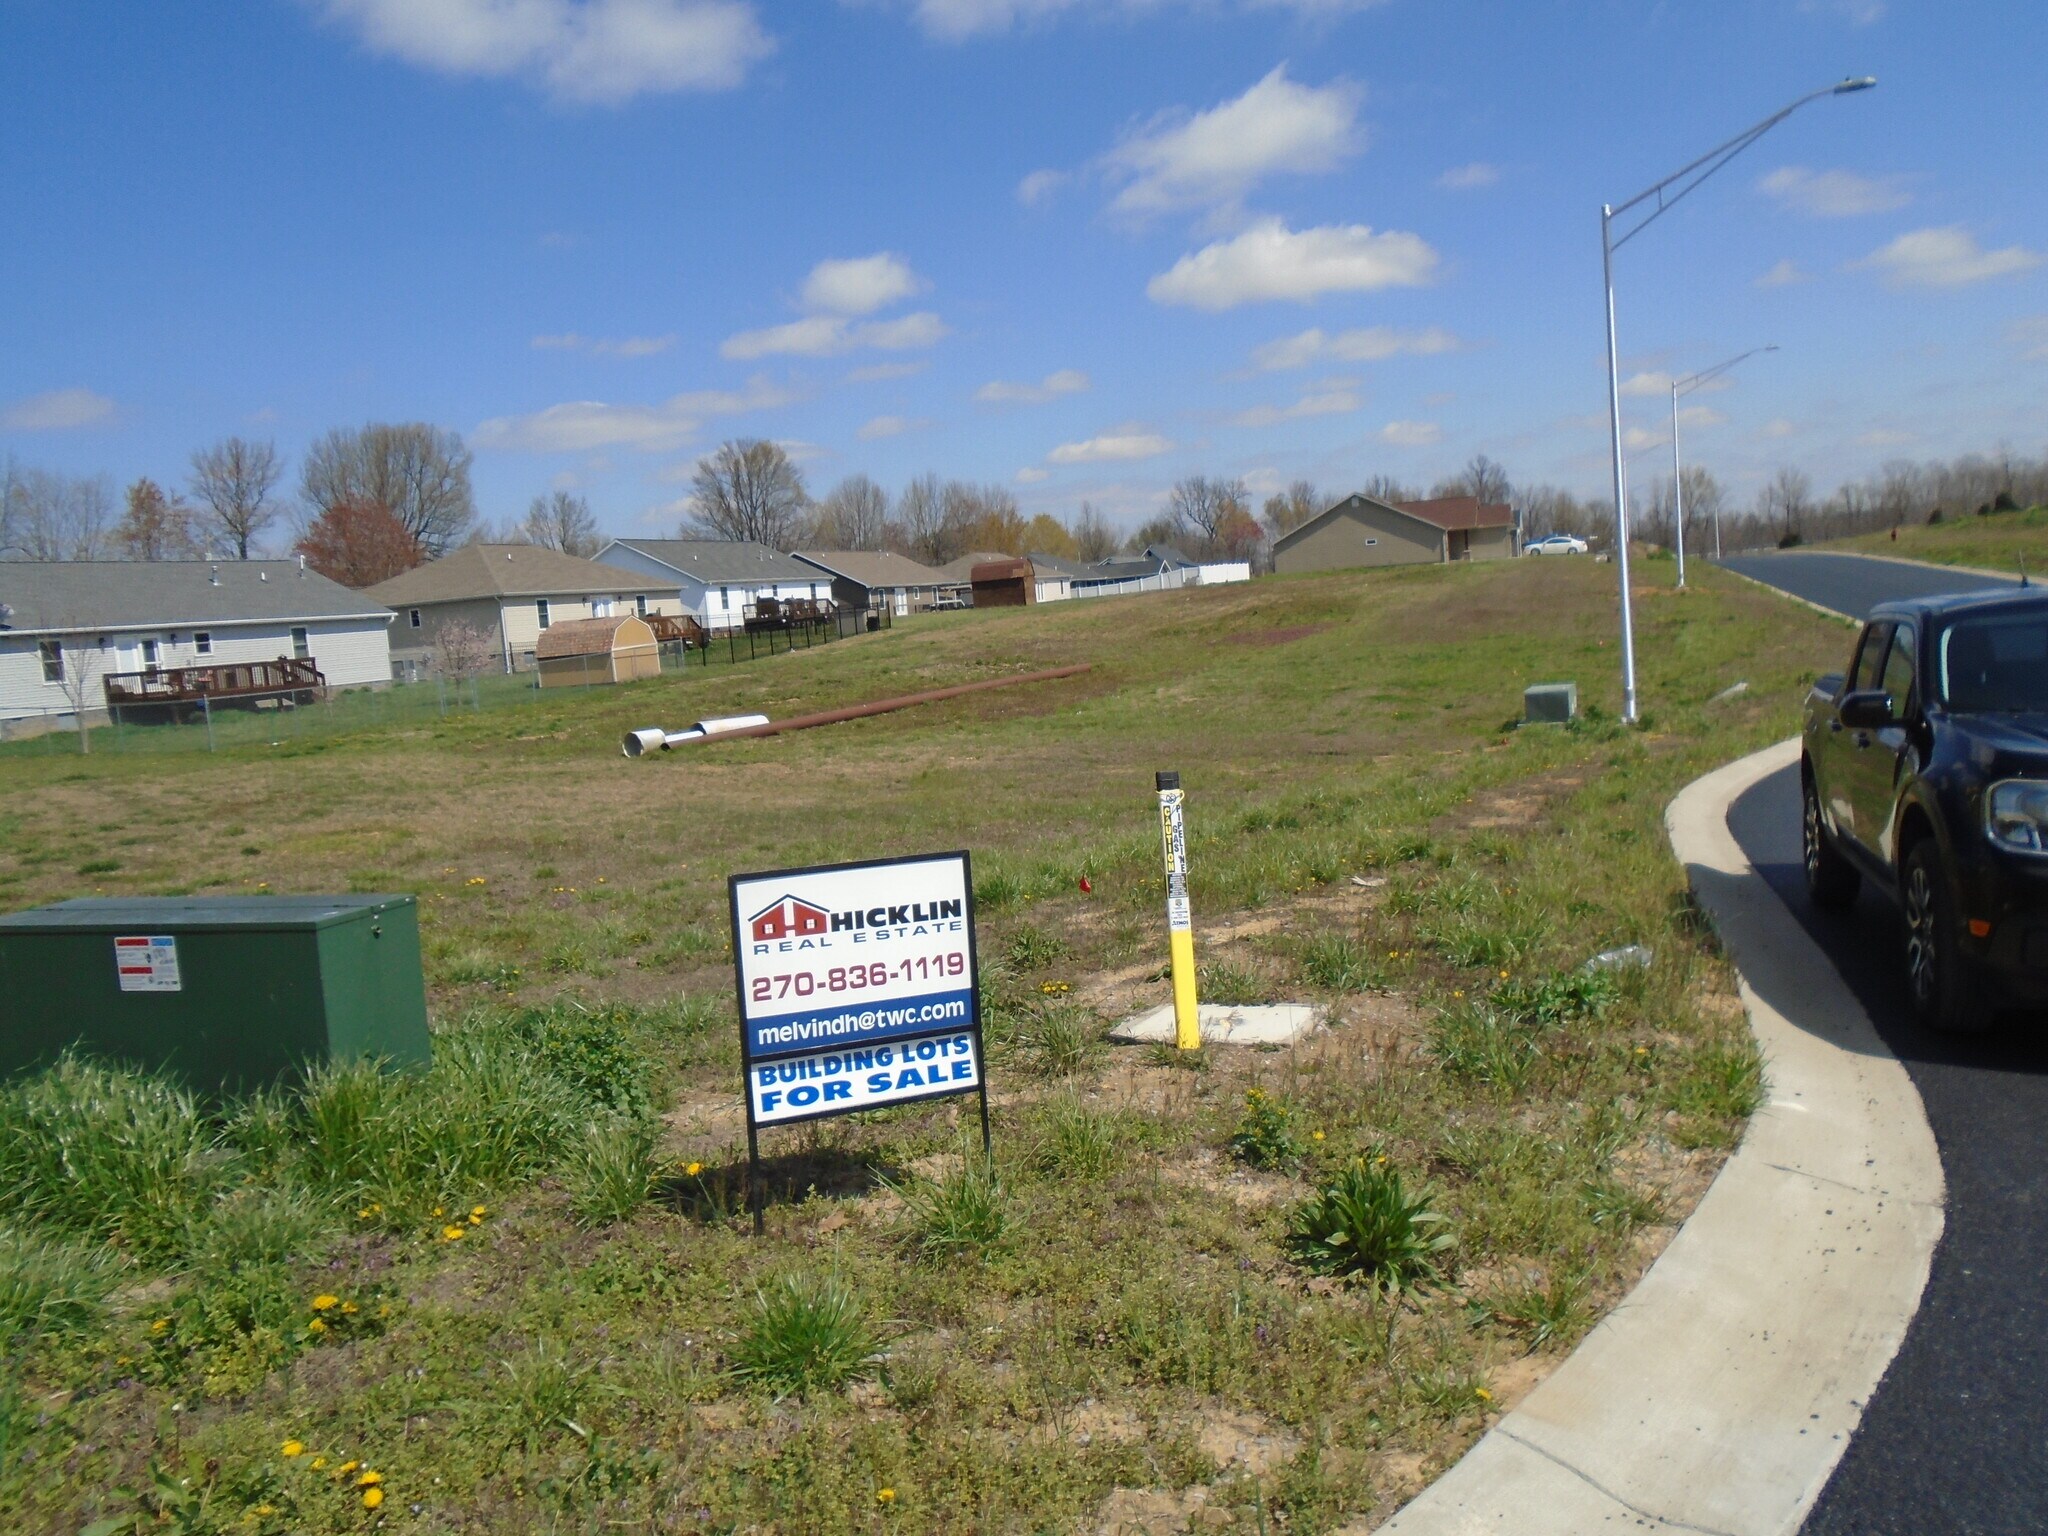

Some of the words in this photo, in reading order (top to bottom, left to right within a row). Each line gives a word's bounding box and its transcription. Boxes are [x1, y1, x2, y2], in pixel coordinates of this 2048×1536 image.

[1164, 807, 1175, 872] CAUTION
[1176, 804, 1185, 872] PIPELINE
[753, 937, 832, 956] REAL
[853, 920, 962, 943] ESTATE
[830, 899, 962, 932] HICKLIN
[752, 952, 964, 1002] 270-836-1119
[758, 1000, 965, 1045] melvindh@twc.com
[758, 1047, 894, 1087] BUILDING
[902, 1035, 969, 1063] LOTS
[761, 1080, 853, 1113] FOR
[867, 1059, 972, 1093] SALE
